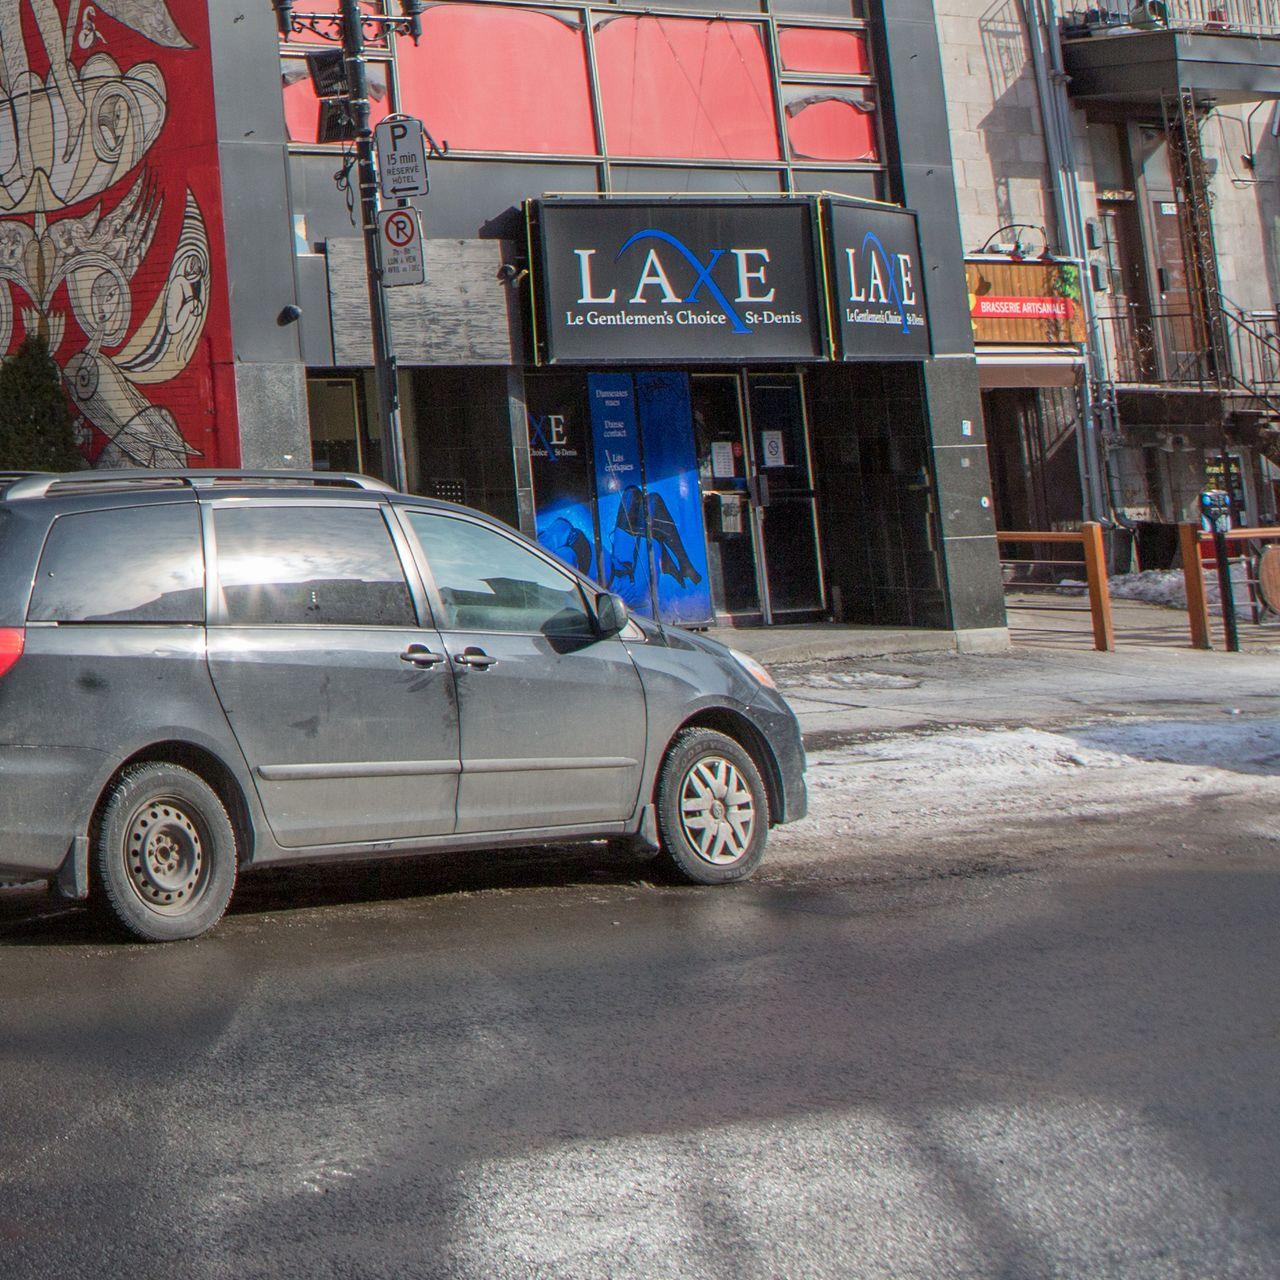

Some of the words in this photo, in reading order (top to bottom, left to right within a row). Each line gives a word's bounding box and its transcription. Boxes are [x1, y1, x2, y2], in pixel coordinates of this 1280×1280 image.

[387, 154, 397, 166] 15
[400, 151, 417, 164] min
[574, 230, 776, 333] LAXE
[981, 301, 1021, 313] BRASSERIE
[1022, 302, 1066, 314] ARTISANALE
[566, 311, 578, 325] Le
[580, 310, 673, 325] Gentlemen's
[676, 310, 726, 324] Choice
[745, 311, 802, 324] St-Denis
